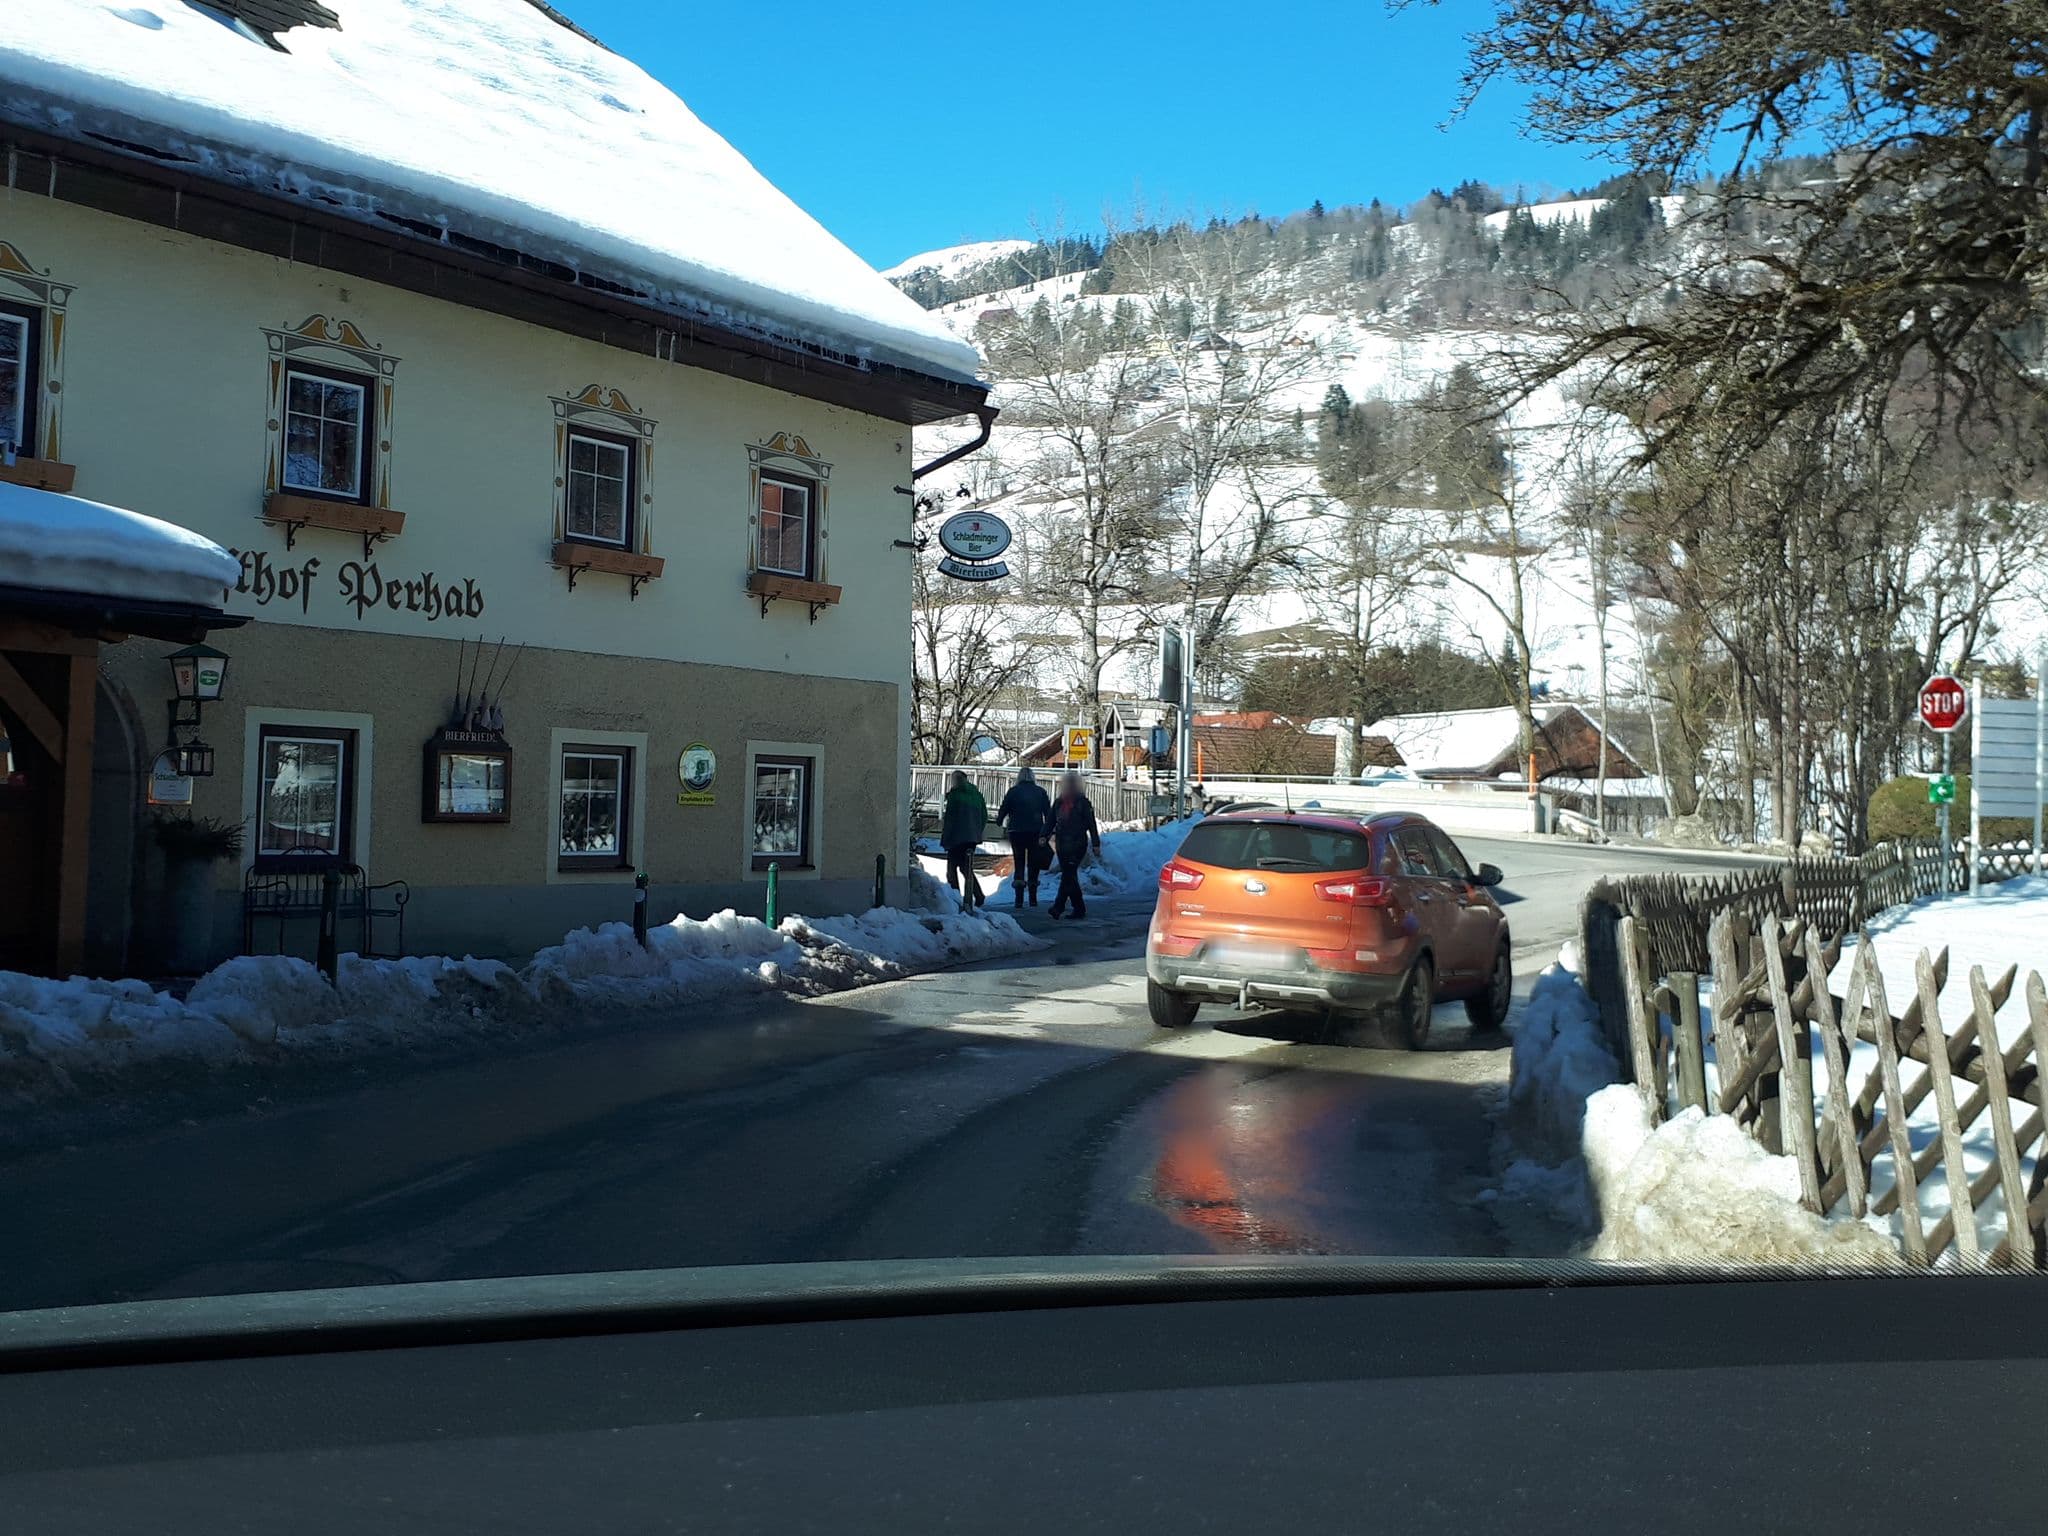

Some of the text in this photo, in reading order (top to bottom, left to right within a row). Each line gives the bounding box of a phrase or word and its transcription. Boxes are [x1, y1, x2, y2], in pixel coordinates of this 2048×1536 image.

[953, 532, 998, 544] Schladminger
[968, 543, 982, 552] Bier
[338, 562, 484, 621] Perhab
[1923, 692, 1961, 714] STOP
